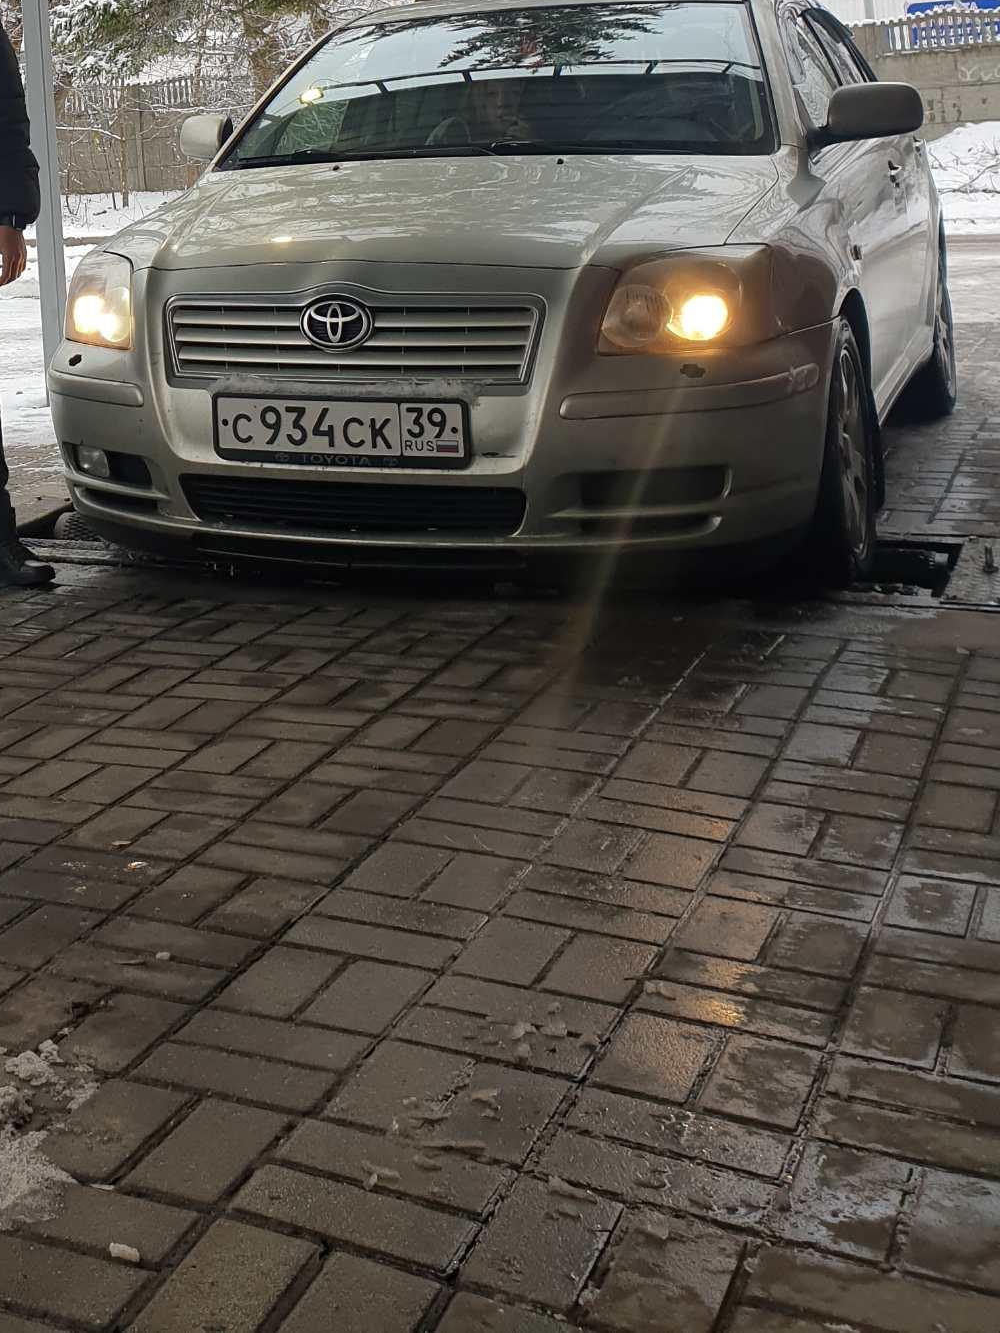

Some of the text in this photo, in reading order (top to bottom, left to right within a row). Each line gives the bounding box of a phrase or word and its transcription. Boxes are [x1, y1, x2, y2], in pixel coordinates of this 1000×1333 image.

[232, 406, 448, 450] С934СК 39
[404, 440, 435, 452] RUS
[302, 454, 371, 466] TOYOTA
